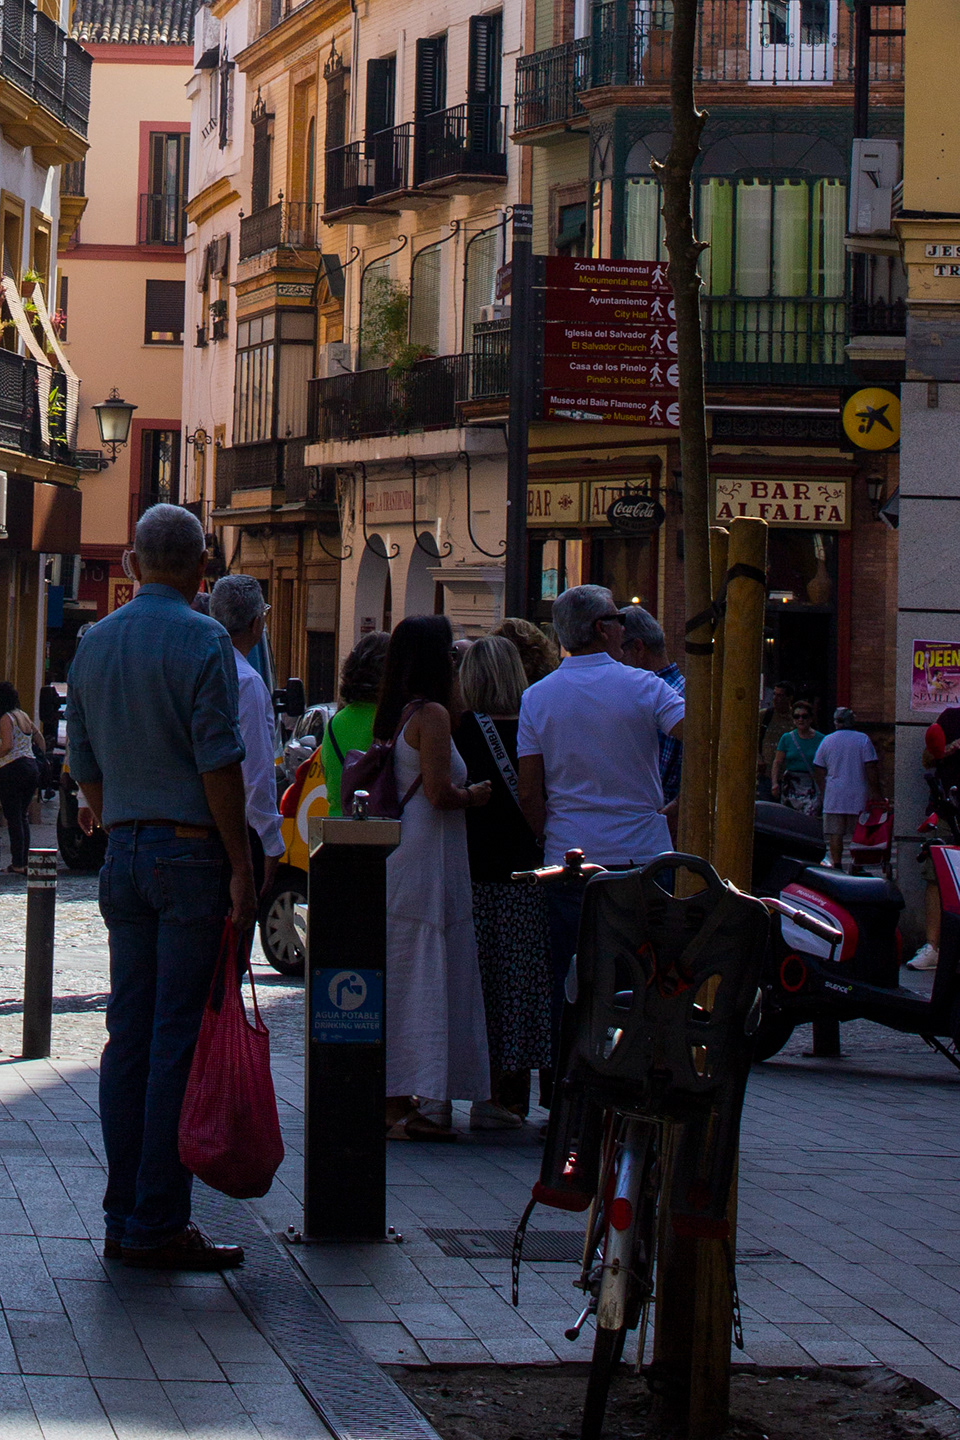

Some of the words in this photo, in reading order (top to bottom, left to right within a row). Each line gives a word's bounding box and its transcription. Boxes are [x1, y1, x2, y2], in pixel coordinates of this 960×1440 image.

[574, 262, 596, 271] Zona
[597, 263, 649, 274] Monumental
[579, 275, 628, 285] Monumental
[630, 278, 648, 286] area
[589, 296, 648, 306] Ayuntamiento
[614, 310, 631, 319] City
[632, 311, 648, 319] Hall
[565, 328, 593, 338] Iglesia
[594, 329, 607, 338] del
[609, 330, 647, 339] Salvador
[571, 341, 580, 350] El
[582, 342, 616, 350] Salvador
[618, 343, 647, 352] Church
[569, 362, 591, 370] Casa
[592, 362, 604, 371] de
[605, 363, 619, 371] los
[620, 363, 647, 372] Pinelo
[621, 376, 646, 385] House
[550, 396, 575, 405] Museo
[577, 397, 589, 405] del
[590, 398, 609, 407] Baile
[610, 400, 647, 409] Flamenco
[613, 412, 646, 422] Museum
[751, 481, 811, 500] BAR
[527, 490, 551, 516] BAR
[717, 502, 843, 522] ALFALFA
[914, 650, 960, 670] QUEEN
[913, 691, 960, 704] SEVILLA
[315, 1011, 340, 1019] AGUA
[342, 1012, 380, 1020] POTABLE
[314, 1022, 352, 1030] DRINKING
[354, 1022, 380, 1030] WATER
